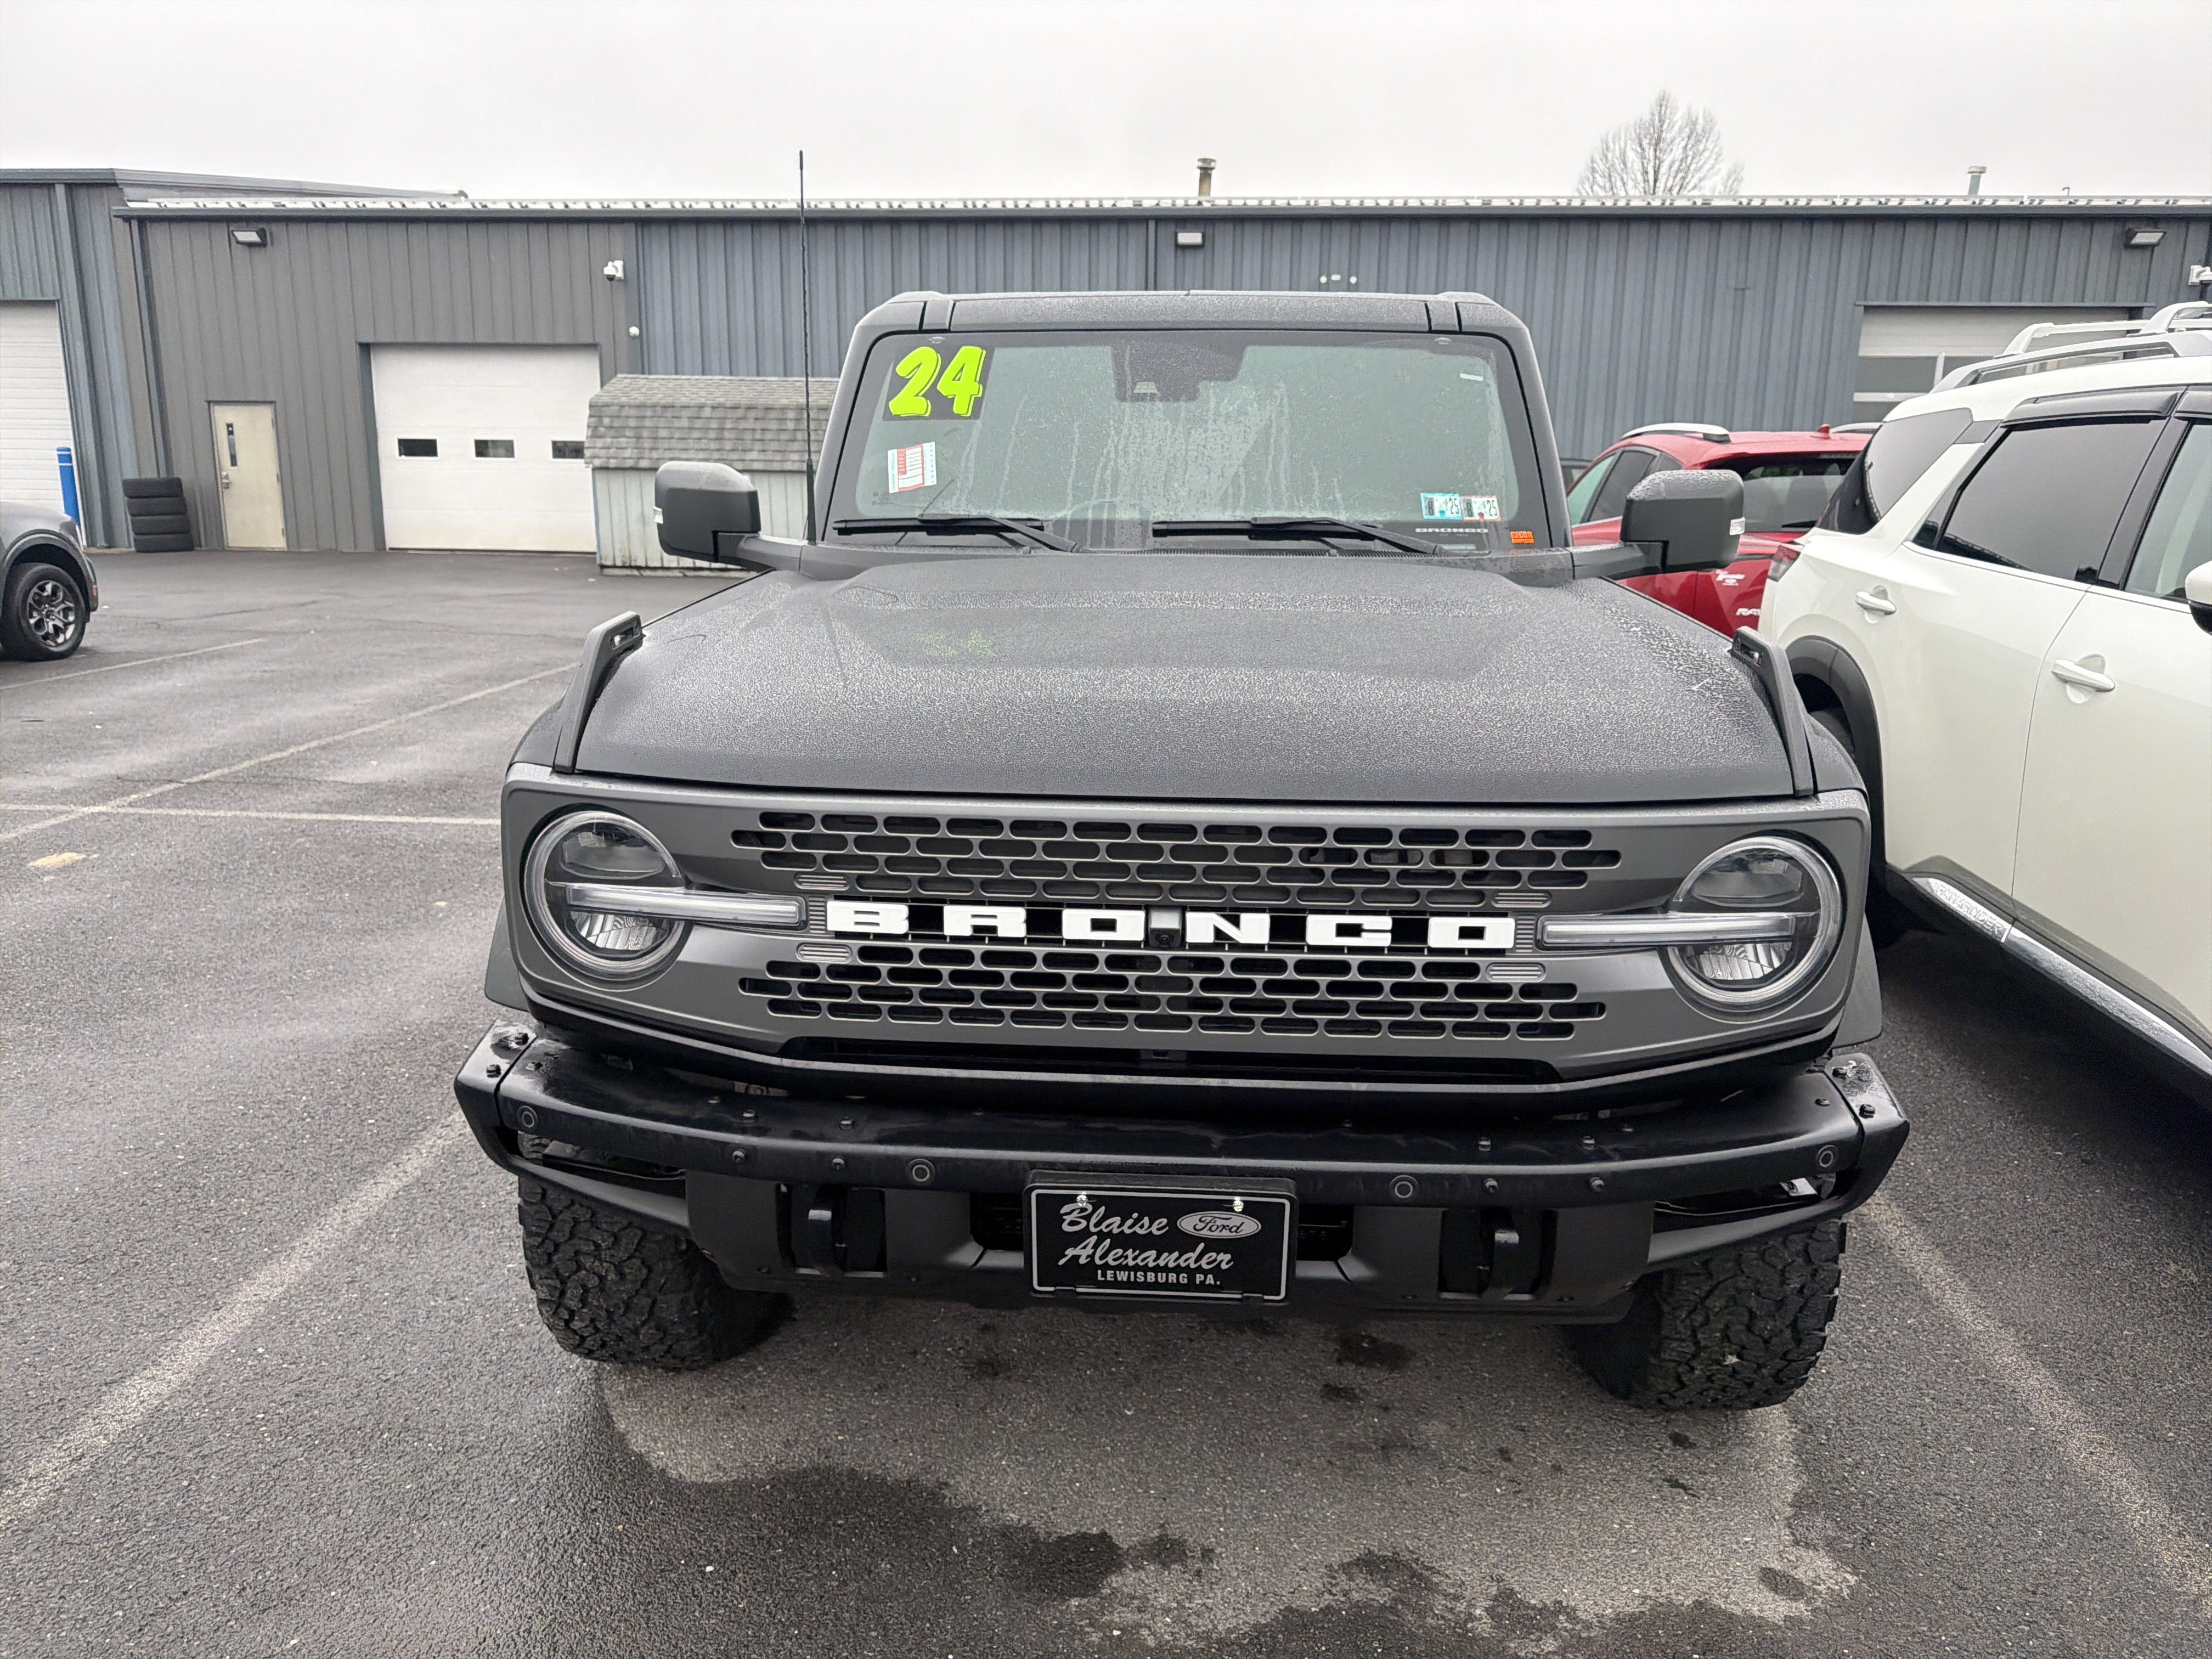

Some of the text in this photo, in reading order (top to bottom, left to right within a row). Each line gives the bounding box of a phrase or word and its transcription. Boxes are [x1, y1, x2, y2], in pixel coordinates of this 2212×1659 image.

[888, 345, 986, 417] 24
[1449, 497, 1459, 515] 25
[1487, 499, 1498, 517] 25
[1735, 608, 1761, 616] RA
[826, 900, 1515, 949] BRONCO
[1059, 1203, 1170, 1236] Blaise
[1193, 1214, 1245, 1235] Ford
[1058, 1235, 1234, 1270] Alexander
[1097, 1269, 1221, 1285] LEWISBURG PA.
